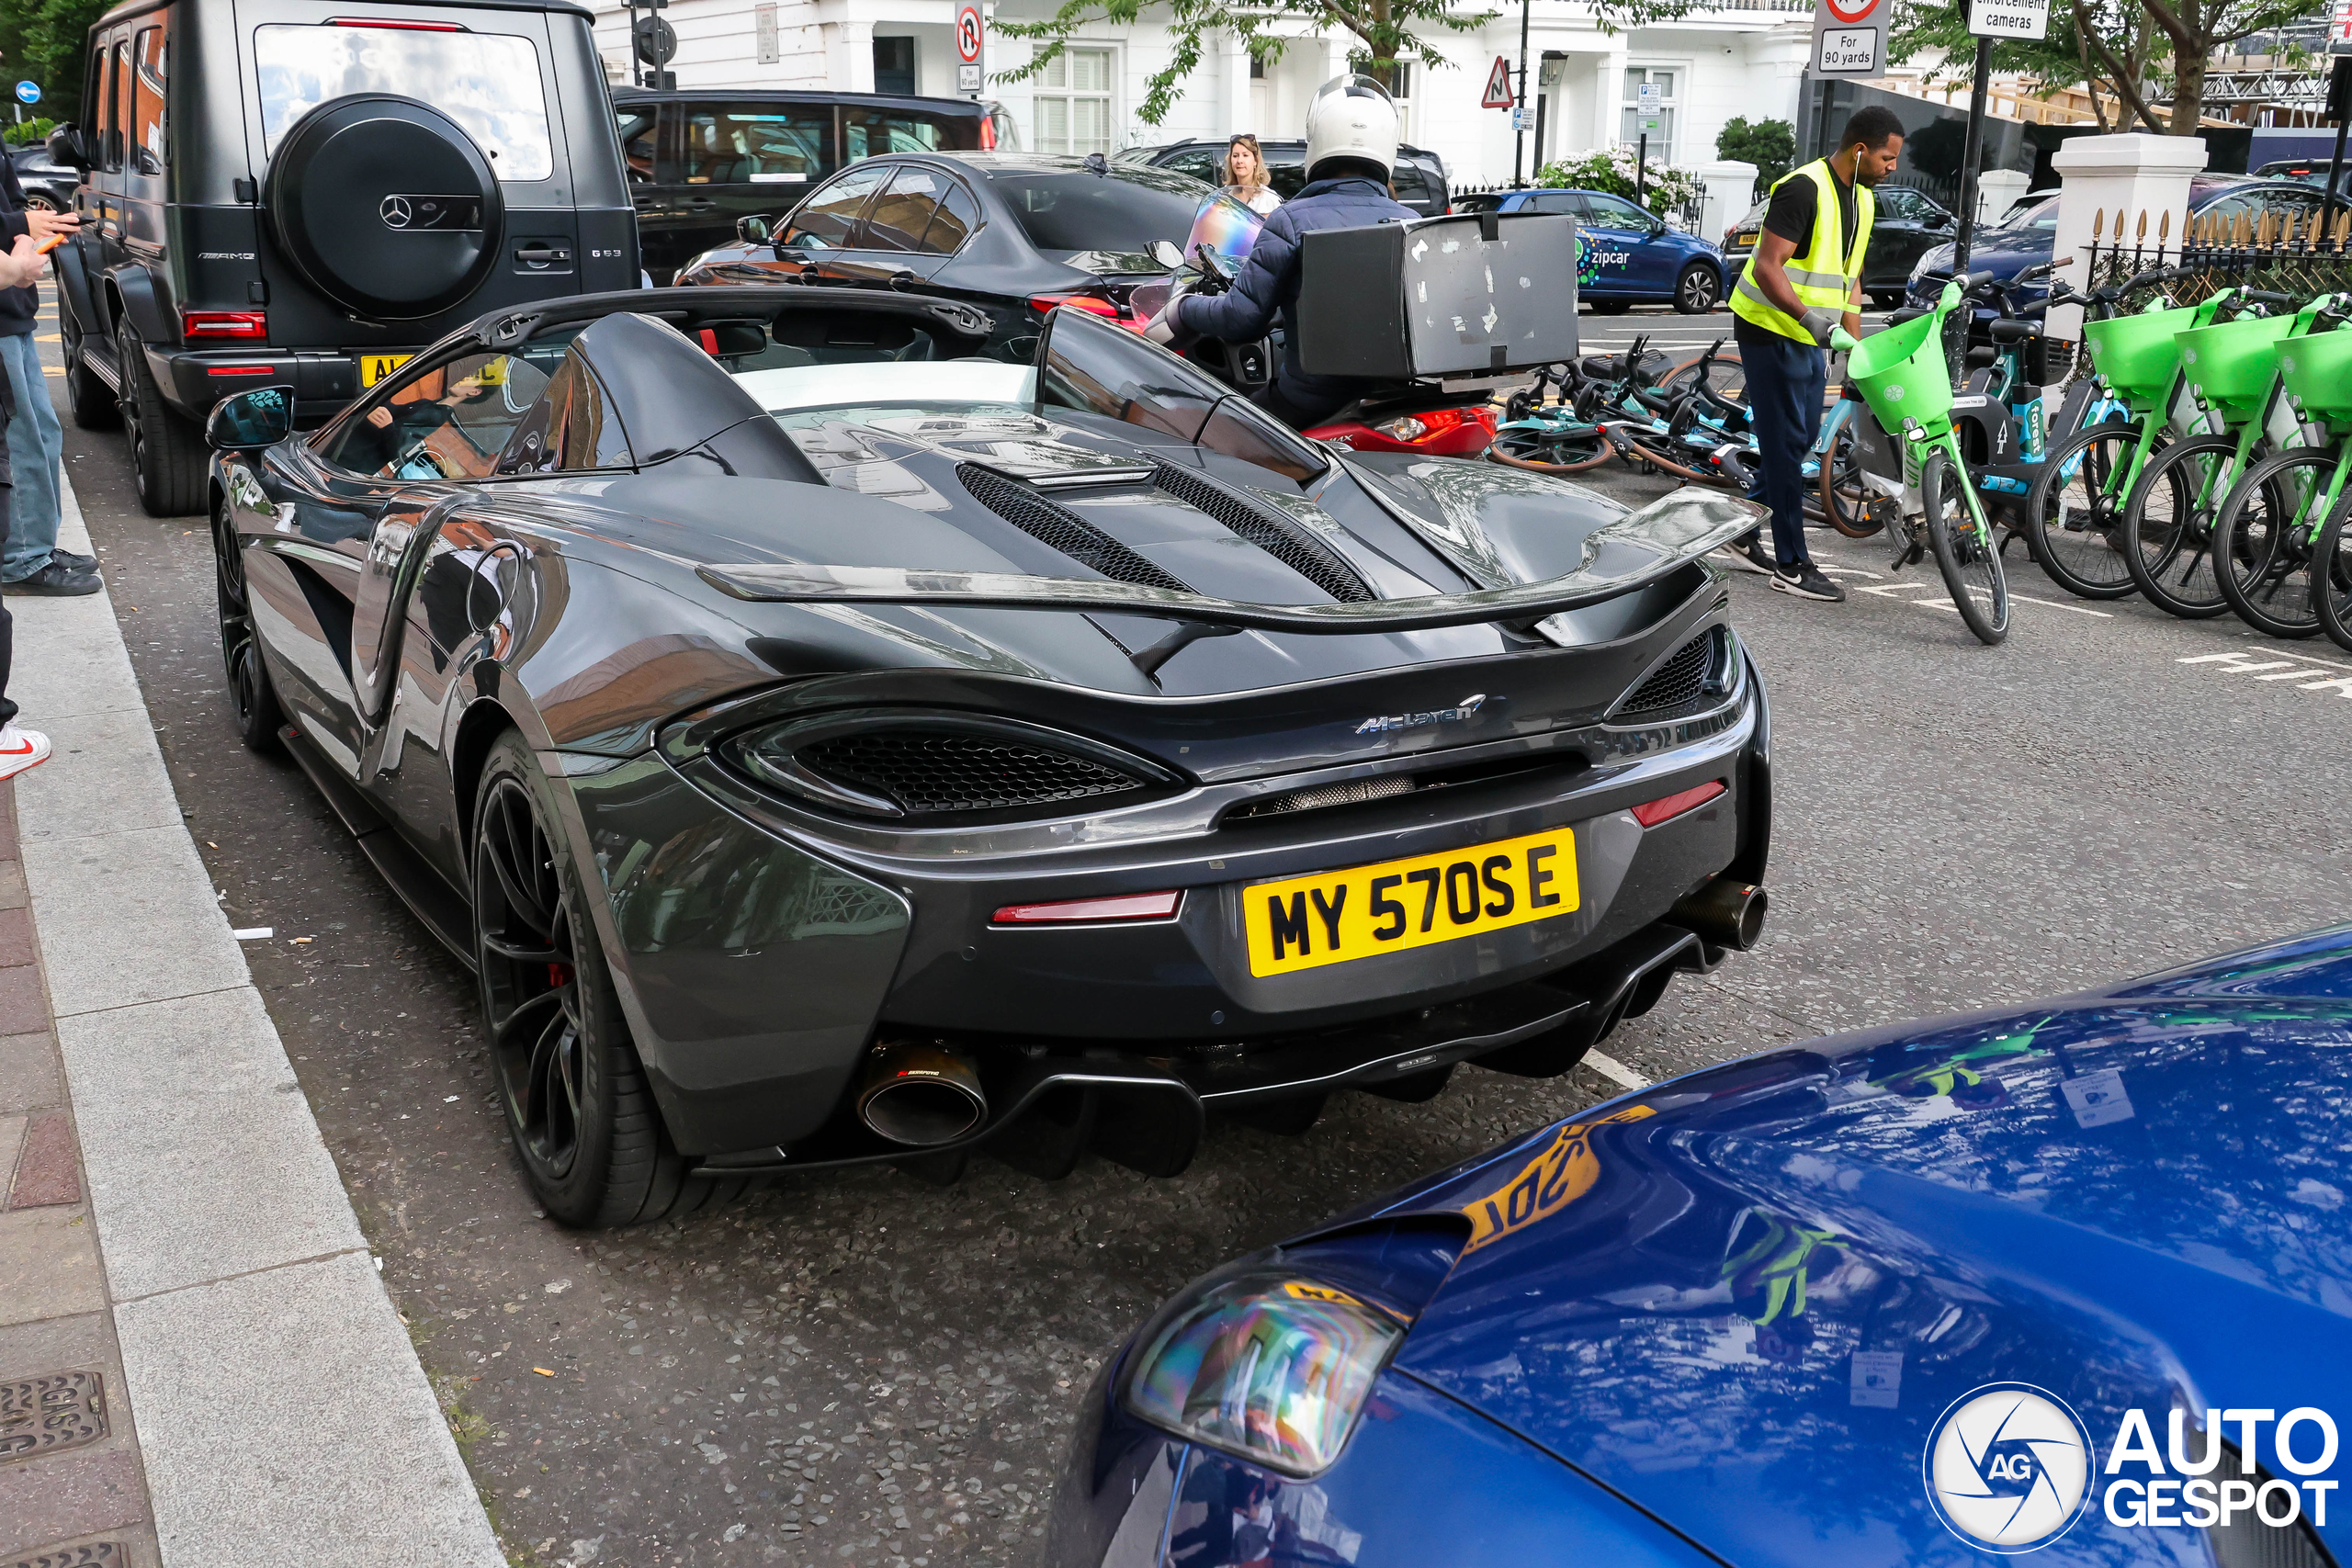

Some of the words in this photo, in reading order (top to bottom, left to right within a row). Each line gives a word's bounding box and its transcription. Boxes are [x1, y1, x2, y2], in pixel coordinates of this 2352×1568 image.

[1976, 0, 2046, 10] rcement
[1986, 14, 2032, 29] cameras
[1840, 36, 1858, 48] For
[1825, 51, 1839, 63] 90
[1841, 51, 1871, 65] yards
[592, 249, 601, 258] G
[603, 249, 622, 257] 63
[1591, 249, 1631, 268] zipcar
[2030, 405, 2041, 455] forest
[1354, 703, 1474, 735] McLaren
[1268, 884, 1347, 961] MY
[1369, 853, 1515, 942] 570S
[1526, 843, 1561, 909] E
[571, 912, 599, 1092] MICHELIN
[40, 1387, 81, 1430] GAS
